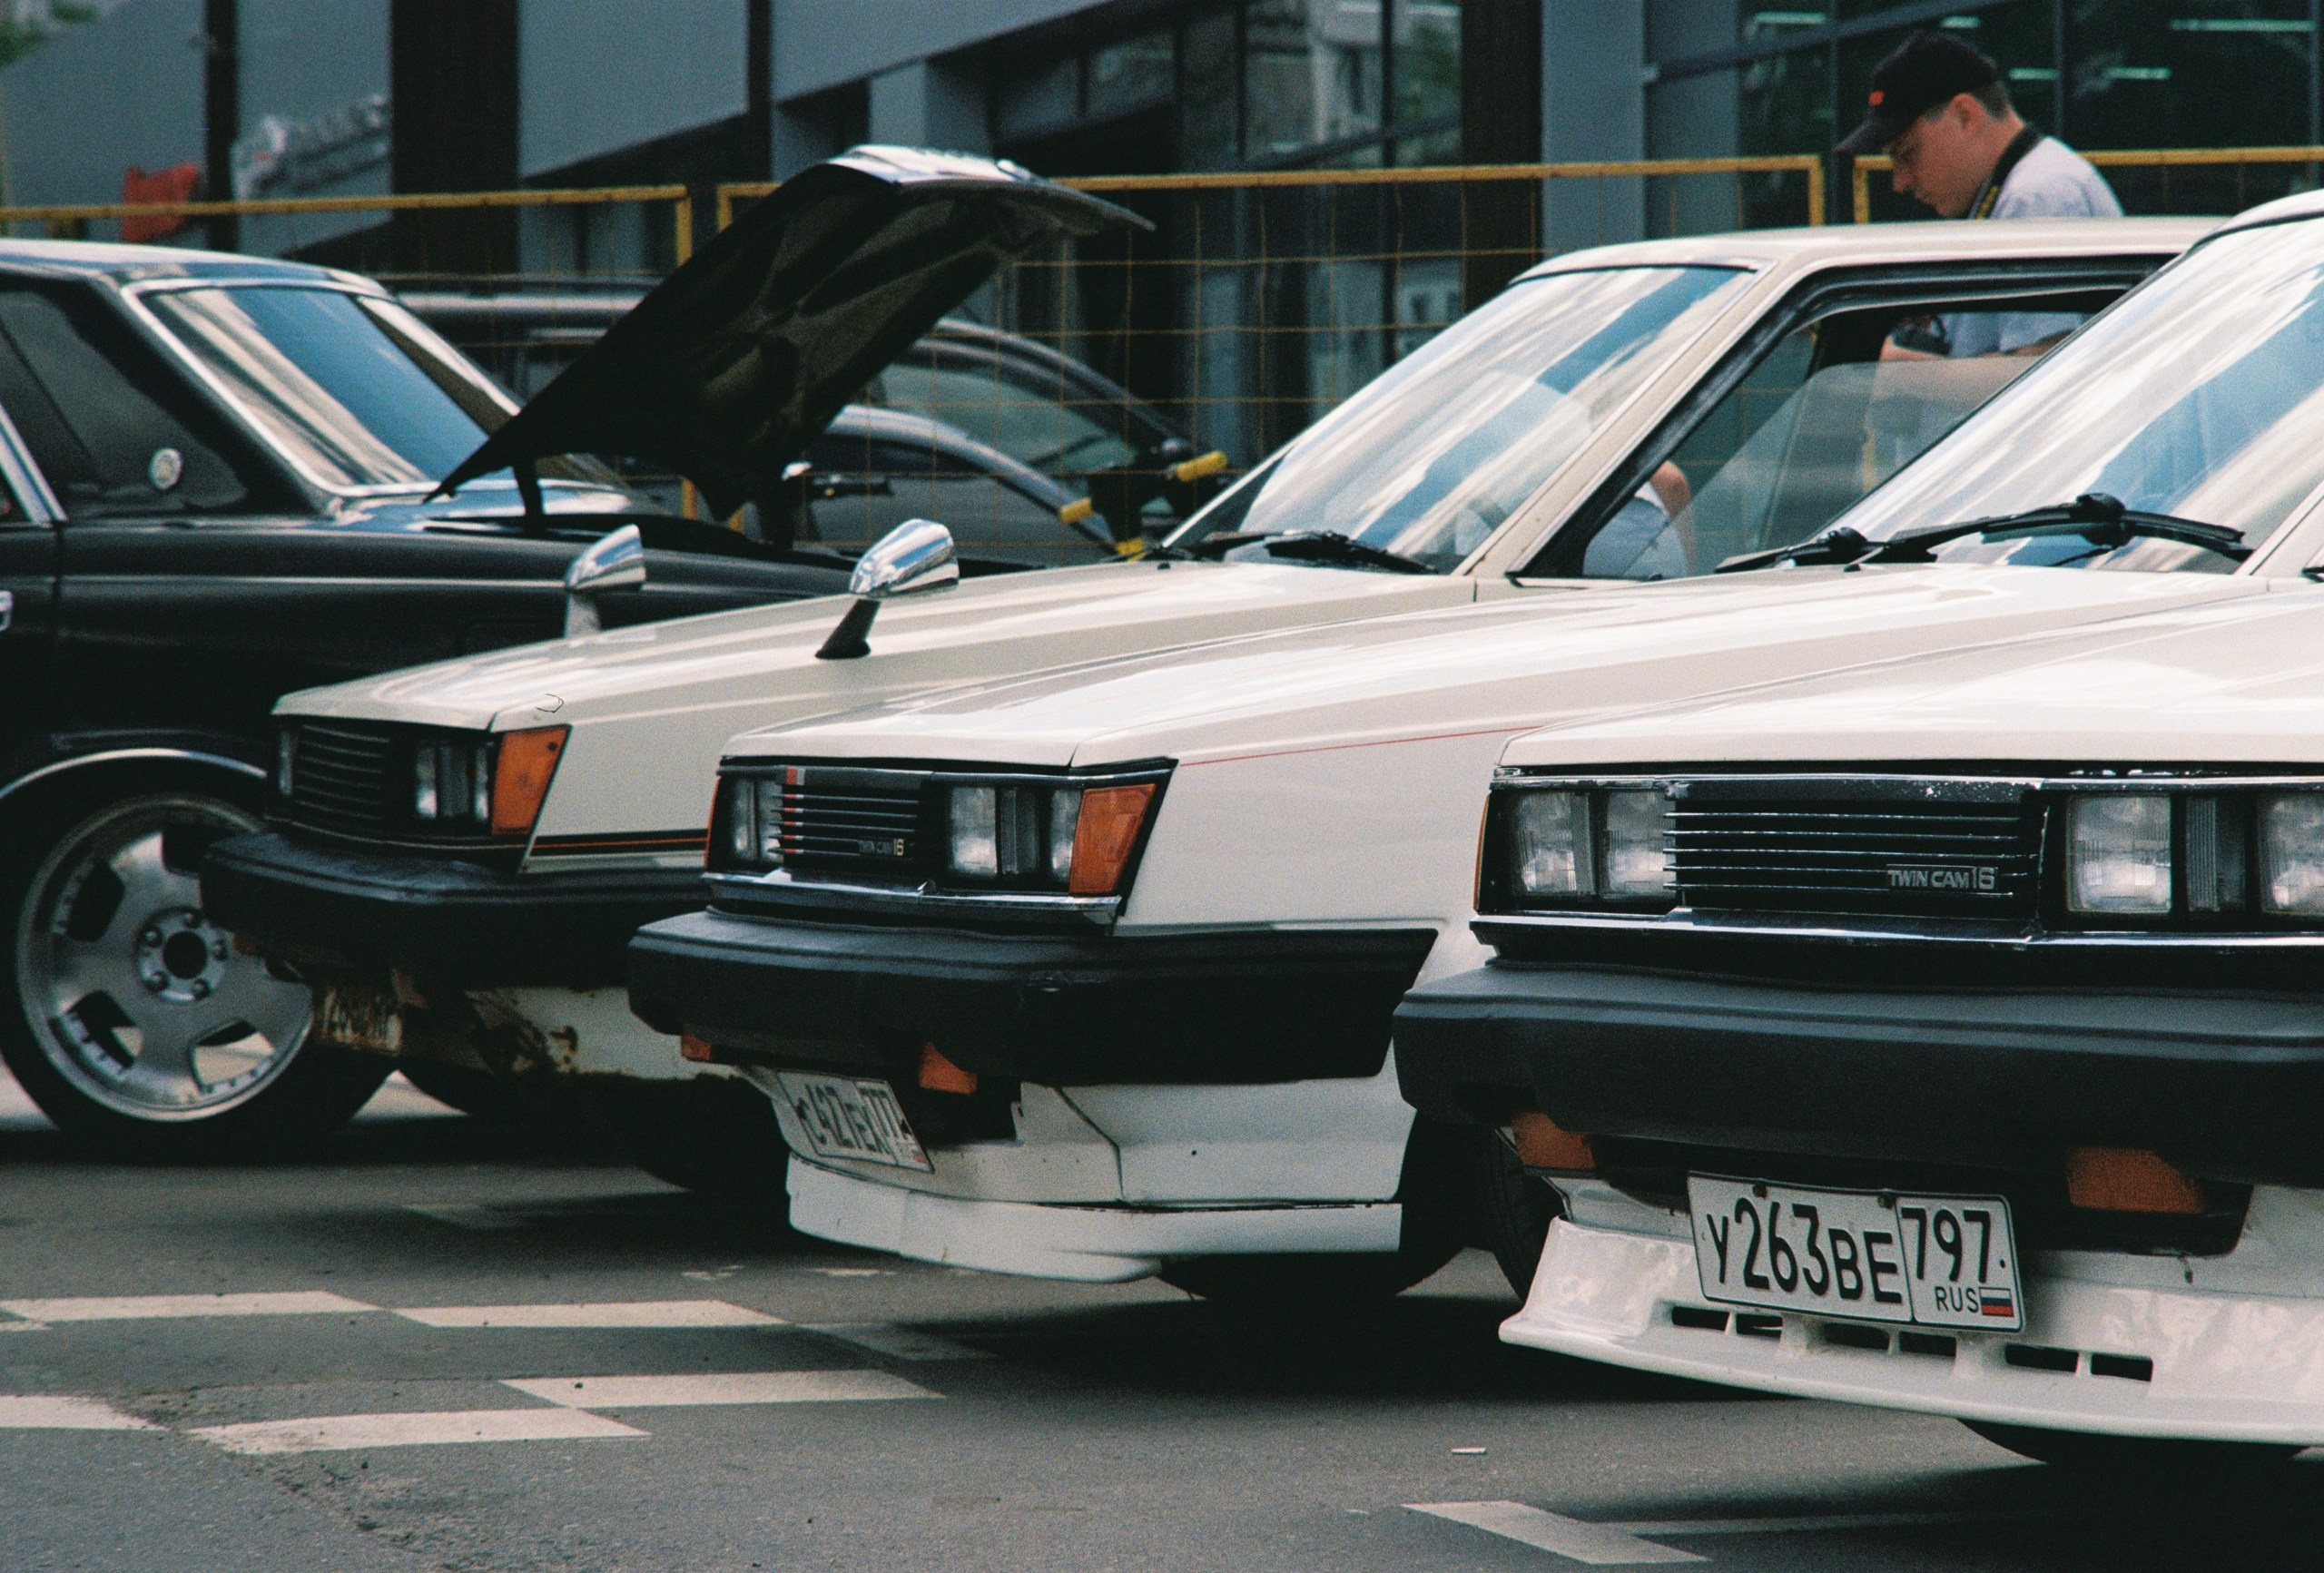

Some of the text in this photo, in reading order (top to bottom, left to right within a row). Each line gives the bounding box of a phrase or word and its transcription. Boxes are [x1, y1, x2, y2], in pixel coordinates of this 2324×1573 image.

[1887, 867, 1995, 890] TWIN CAM 16
[1901, 1206, 1992, 1284] 797
[1935, 1285, 1979, 1313] RUS
